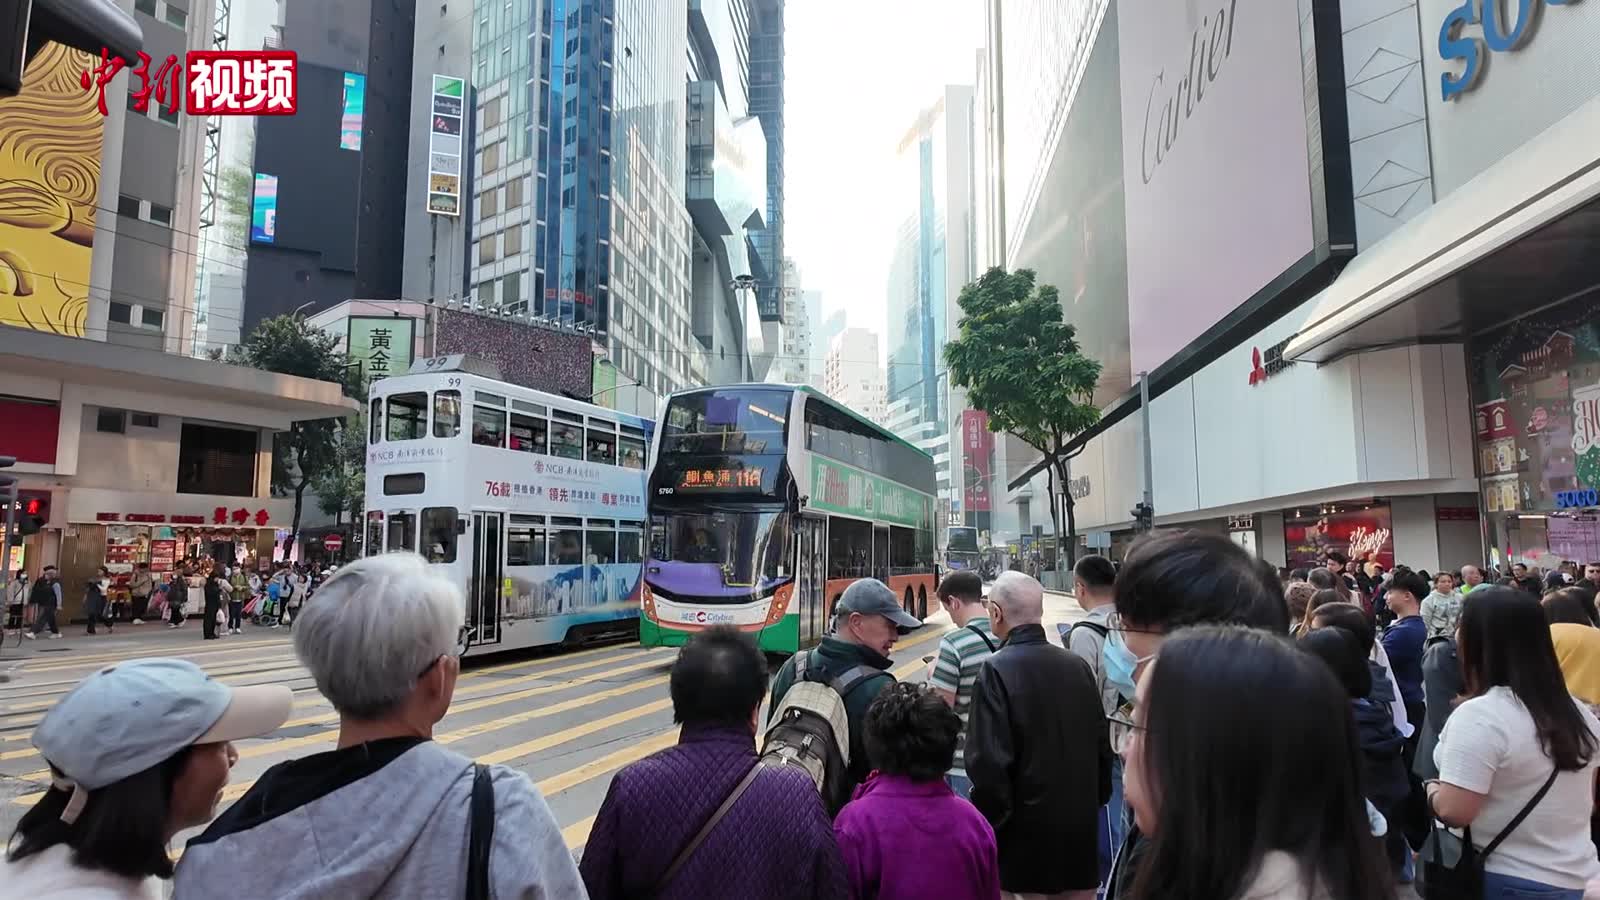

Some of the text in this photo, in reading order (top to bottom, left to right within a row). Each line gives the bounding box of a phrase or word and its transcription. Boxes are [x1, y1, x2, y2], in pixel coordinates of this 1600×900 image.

[1142, 0, 1236, 184] Cartier
[426, 357, 447, 370] 99
[448, 378, 460, 387] 99
[378, 451, 394, 460] NCB
[545, 463, 564, 475] NCB
[658, 487, 674, 495] 5760
[1555, 488, 1598, 509] SOGO
